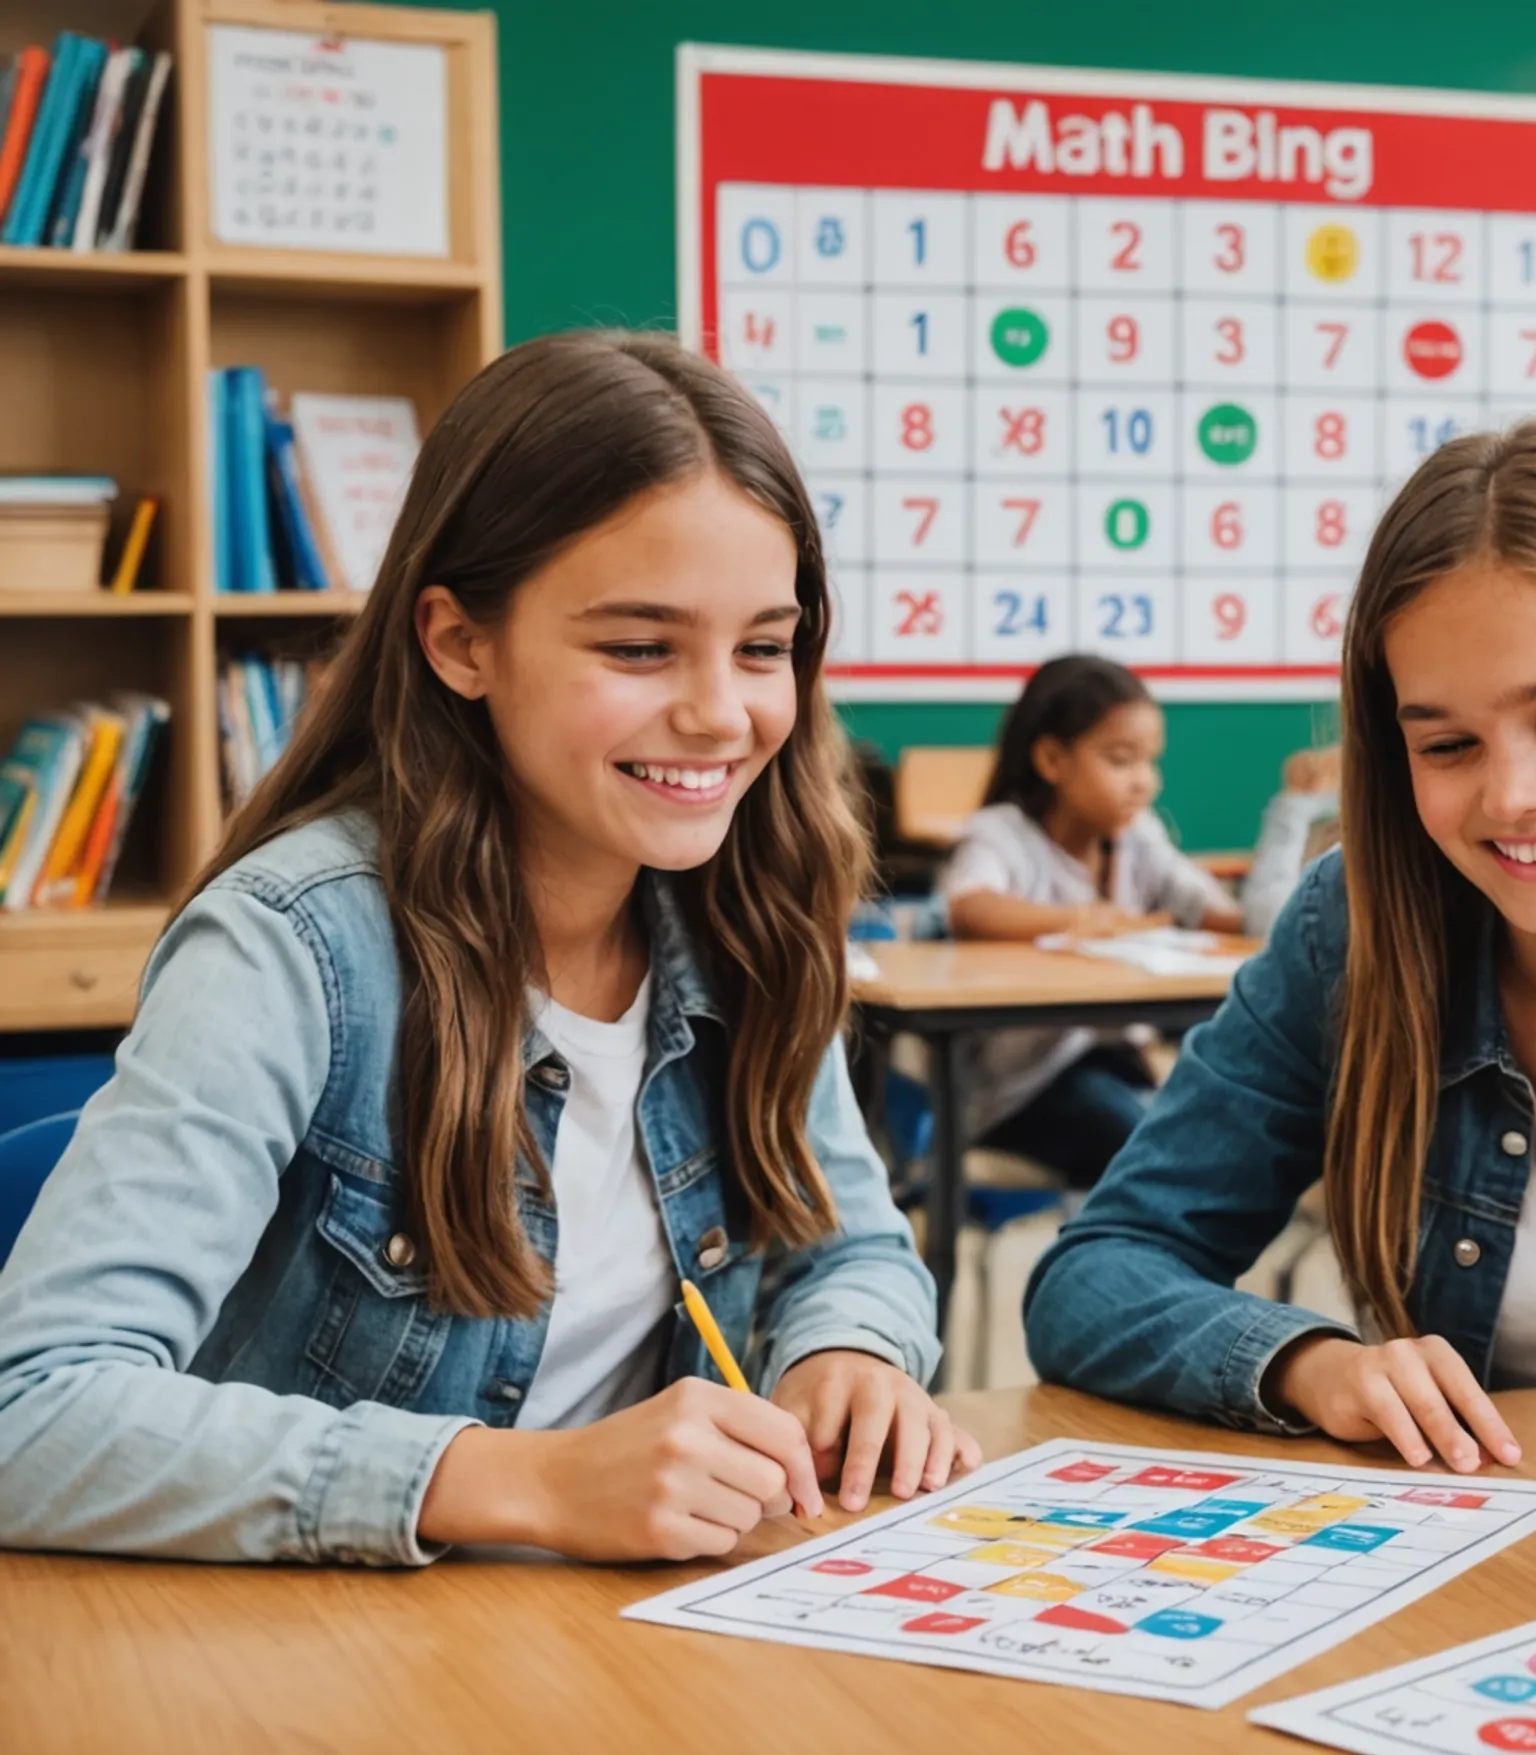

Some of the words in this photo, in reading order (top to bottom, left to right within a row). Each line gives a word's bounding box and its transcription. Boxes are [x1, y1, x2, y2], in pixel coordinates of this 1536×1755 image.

[983, 99, 1184, 178] Math
[906, 218, 927, 265] 1
[1004, 219, 1038, 269] 6
[1108, 221, 1142, 271] 2
[1214, 223, 1245, 273] 3
[1408, 232, 1463, 284] 12
[909, 312, 930, 356] 1
[1106, 314, 1141, 364] 9
[1215, 317, 1245, 366] 3
[1315, 323, 1349, 370] 7
[900, 403, 934, 452] 8
[1102, 408, 1154, 455] 10
[1314, 411, 1347, 460] 8
[902, 498, 939, 545] 7
[1002, 499, 1040, 546] 7
[1210, 503, 1243, 550] 6
[1315, 500, 1347, 548] 8
[1212, 593, 1246, 640] 9
